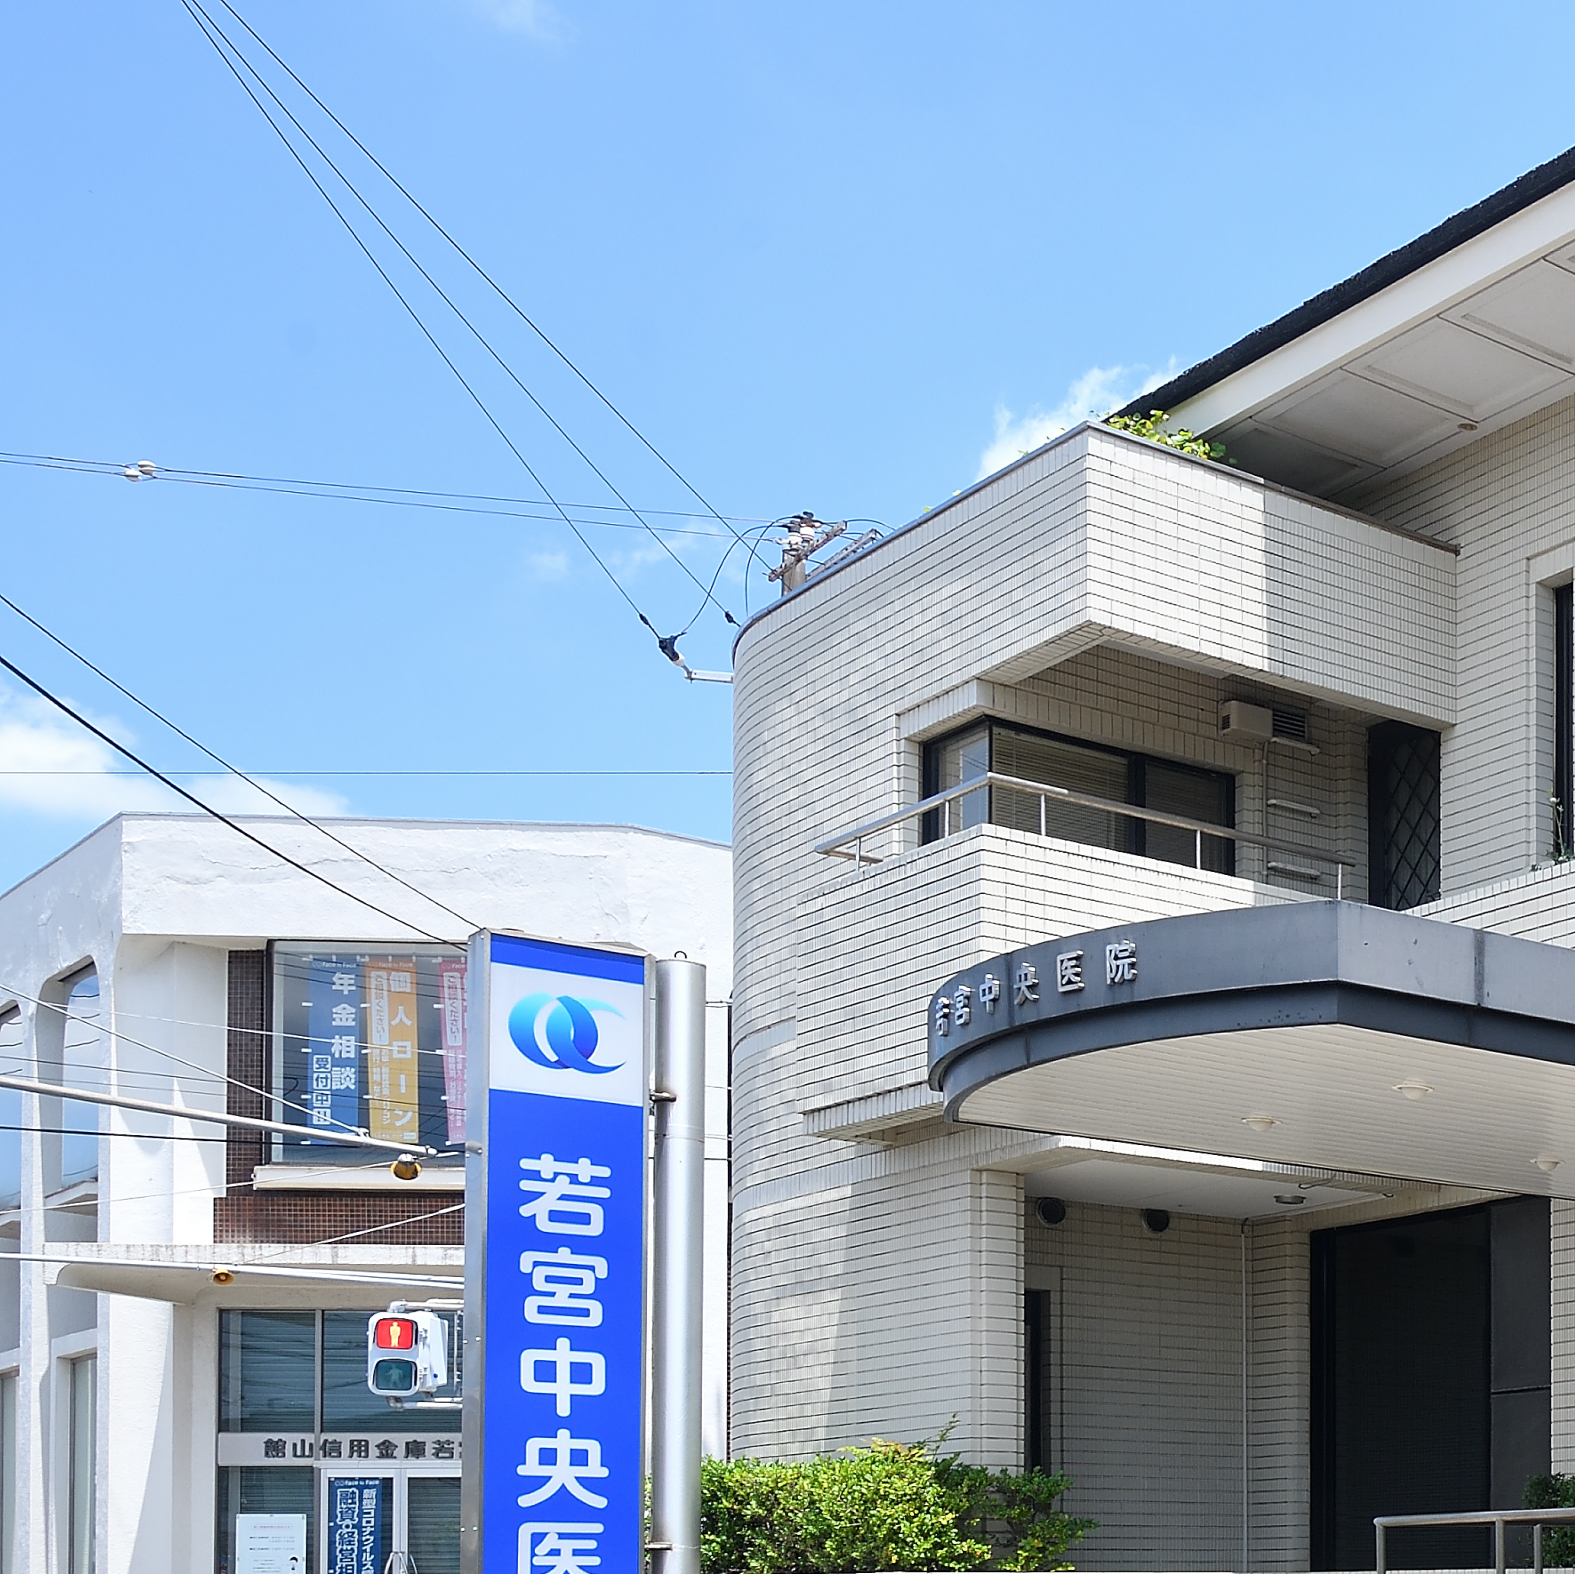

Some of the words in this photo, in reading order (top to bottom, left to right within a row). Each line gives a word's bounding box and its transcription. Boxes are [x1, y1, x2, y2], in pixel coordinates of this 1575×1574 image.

[331, 971, 356, 1091] 年金相談
[935, 939, 1138, 1038] 若宮中央医院
[390, 971, 413, 1128] 個人ローン
[263, 1438, 462, 1460] 館山信用金庫若
